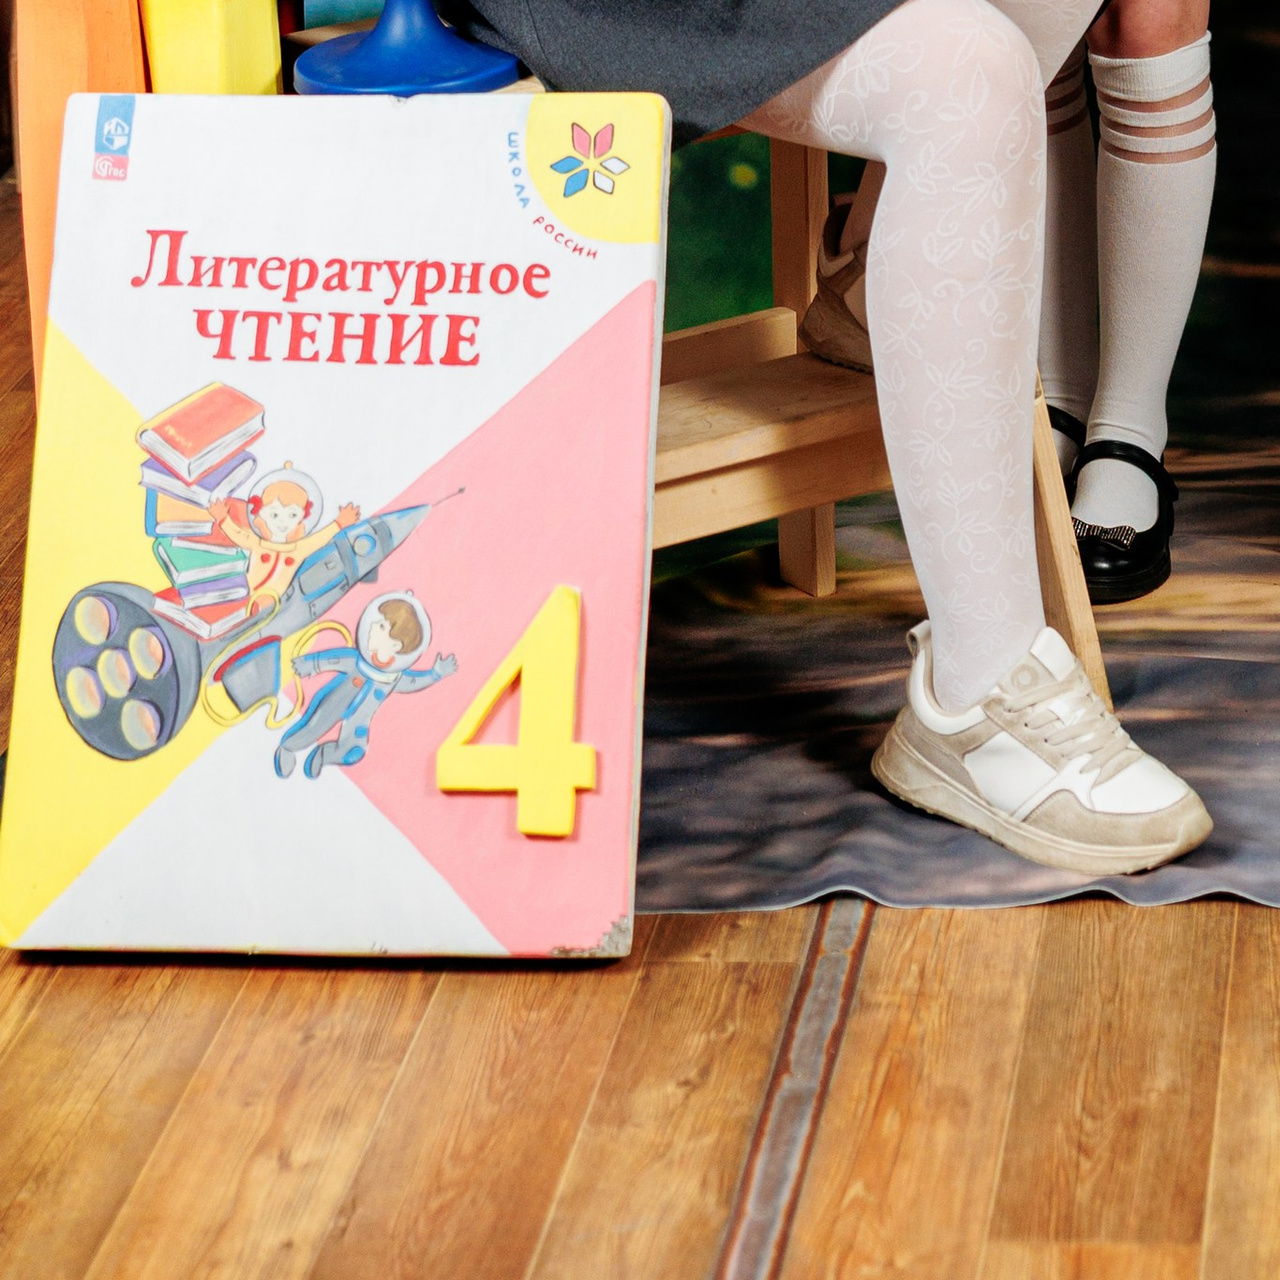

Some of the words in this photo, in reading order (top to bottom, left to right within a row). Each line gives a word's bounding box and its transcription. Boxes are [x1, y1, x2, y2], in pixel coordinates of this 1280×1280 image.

[507, 132, 530, 209] ШКОЛА
[532, 215, 598, 259] РОССИИ
[131, 229, 551, 306] Литературное
[193, 309, 480, 366] ЧТЕНИЕ
[436, 583, 597, 838] 4
